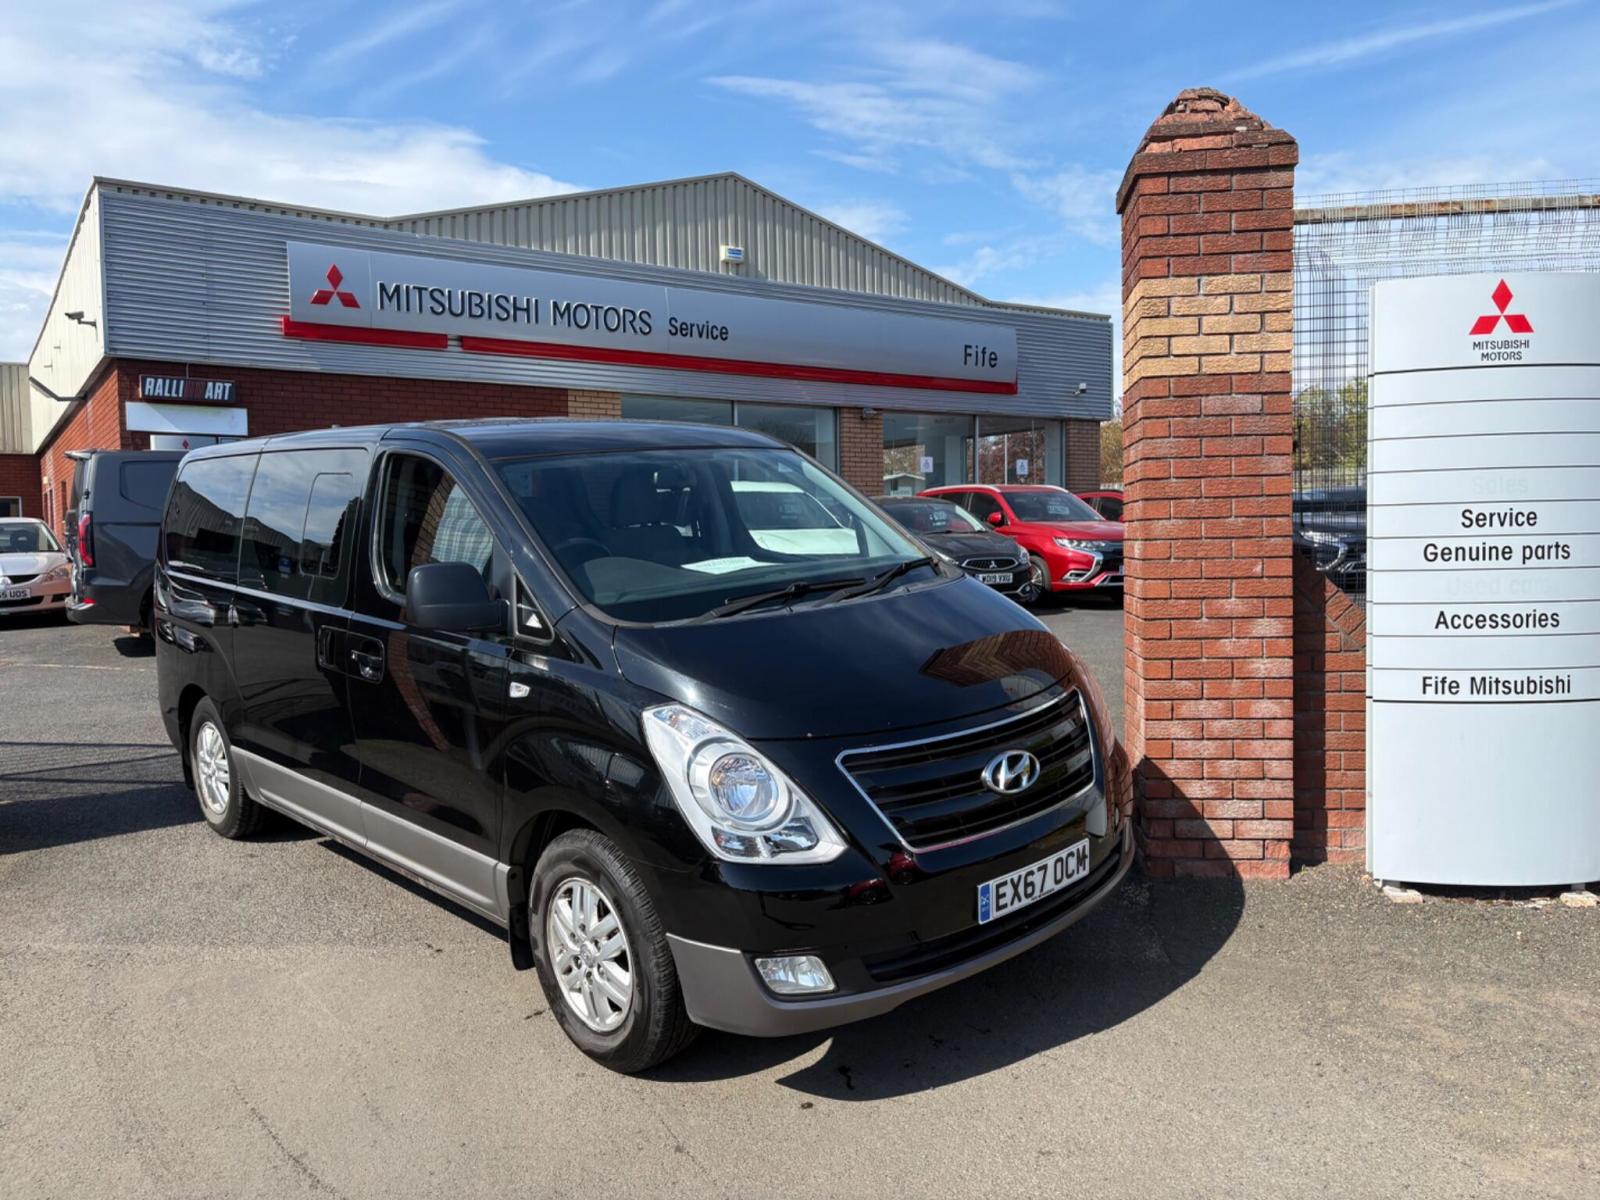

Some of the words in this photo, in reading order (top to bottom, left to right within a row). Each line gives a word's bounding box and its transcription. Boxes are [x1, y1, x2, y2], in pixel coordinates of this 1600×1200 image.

[377, 281, 540, 325] MITSUBISHI
[551, 301, 653, 336] MOTORS
[668, 317, 729, 341] Service
[1472, 339, 1530, 350] MITSUBISHI
[964, 344, 998, 368] Fife
[1481, 351, 1522, 361] MOTORS
[1461, 508, 1538, 528] Service
[1423, 542, 1513, 562] Genuine
[1522, 541, 1571, 565] parts
[1434, 609, 1561, 629] Accessories
[1421, 676, 1460, 695] Fife
[1470, 675, 1571, 695] Mitsubishi
[995, 863, 1048, 912] EX67
[1053, 844, 1088, 885] OCM
